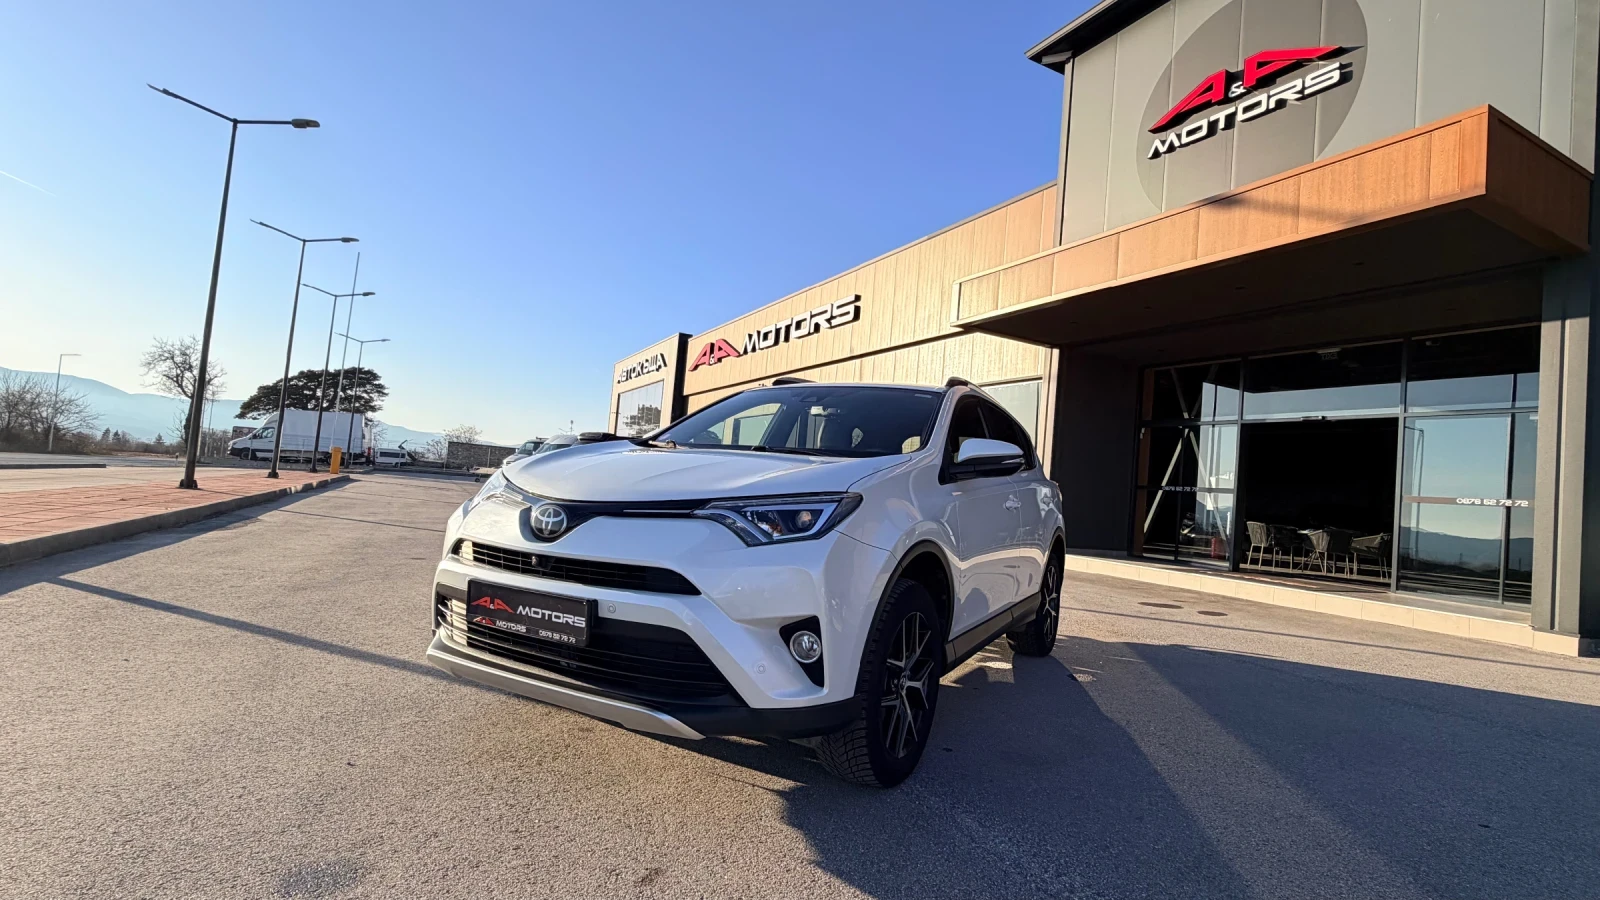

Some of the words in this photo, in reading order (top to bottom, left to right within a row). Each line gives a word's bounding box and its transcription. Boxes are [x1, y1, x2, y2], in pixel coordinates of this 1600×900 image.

[1147, 61, 1341, 158] MOTORS
[1148, 46, 1342, 133] A&A
[688, 338, 741, 371] A&A
[740, 294, 861, 355] MOTORS
[1498, 499, 1512, 507] 72
[471, 596, 514, 614] A&A
[517, 605, 586, 628] MOTORS
[496, 620, 527, 632] MOTORS
